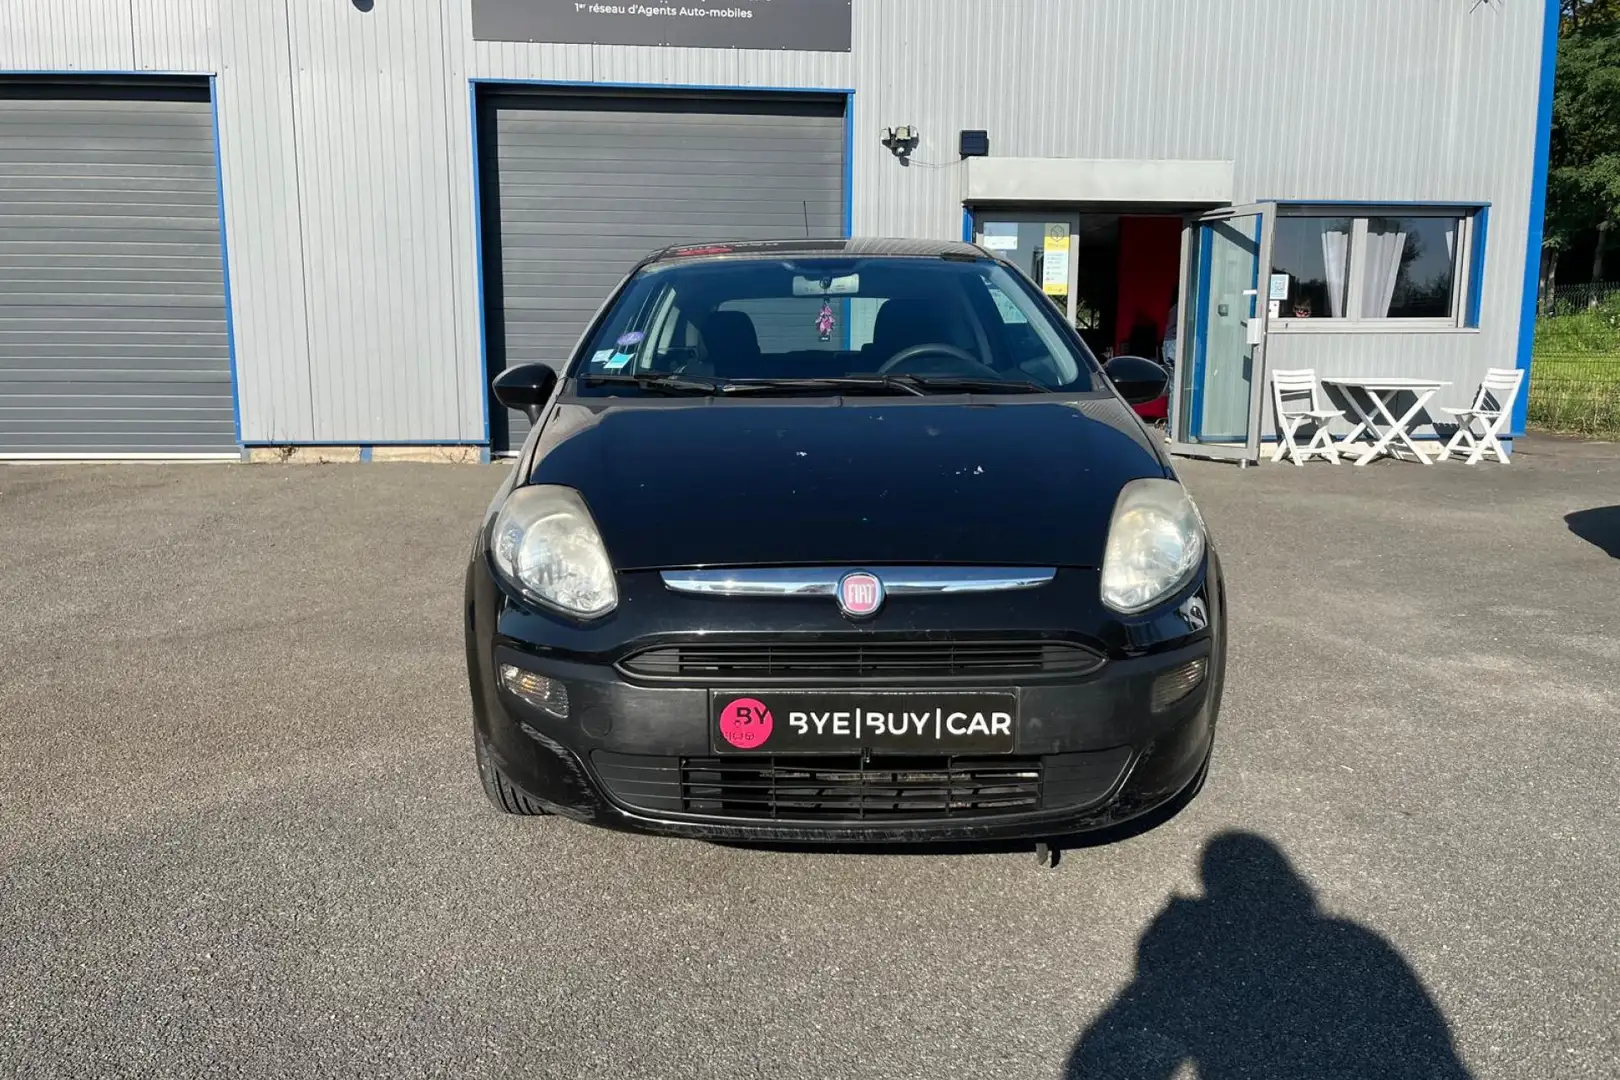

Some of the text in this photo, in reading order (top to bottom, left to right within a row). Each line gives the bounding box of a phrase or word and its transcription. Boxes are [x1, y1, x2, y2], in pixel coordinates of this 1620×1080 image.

[588, 3, 626, 14] réseau
[628, 4, 677, 17] d'Agents
[679, 7, 753, 19] Auto-mobiles
[847, 583, 873, 605] FIAT
